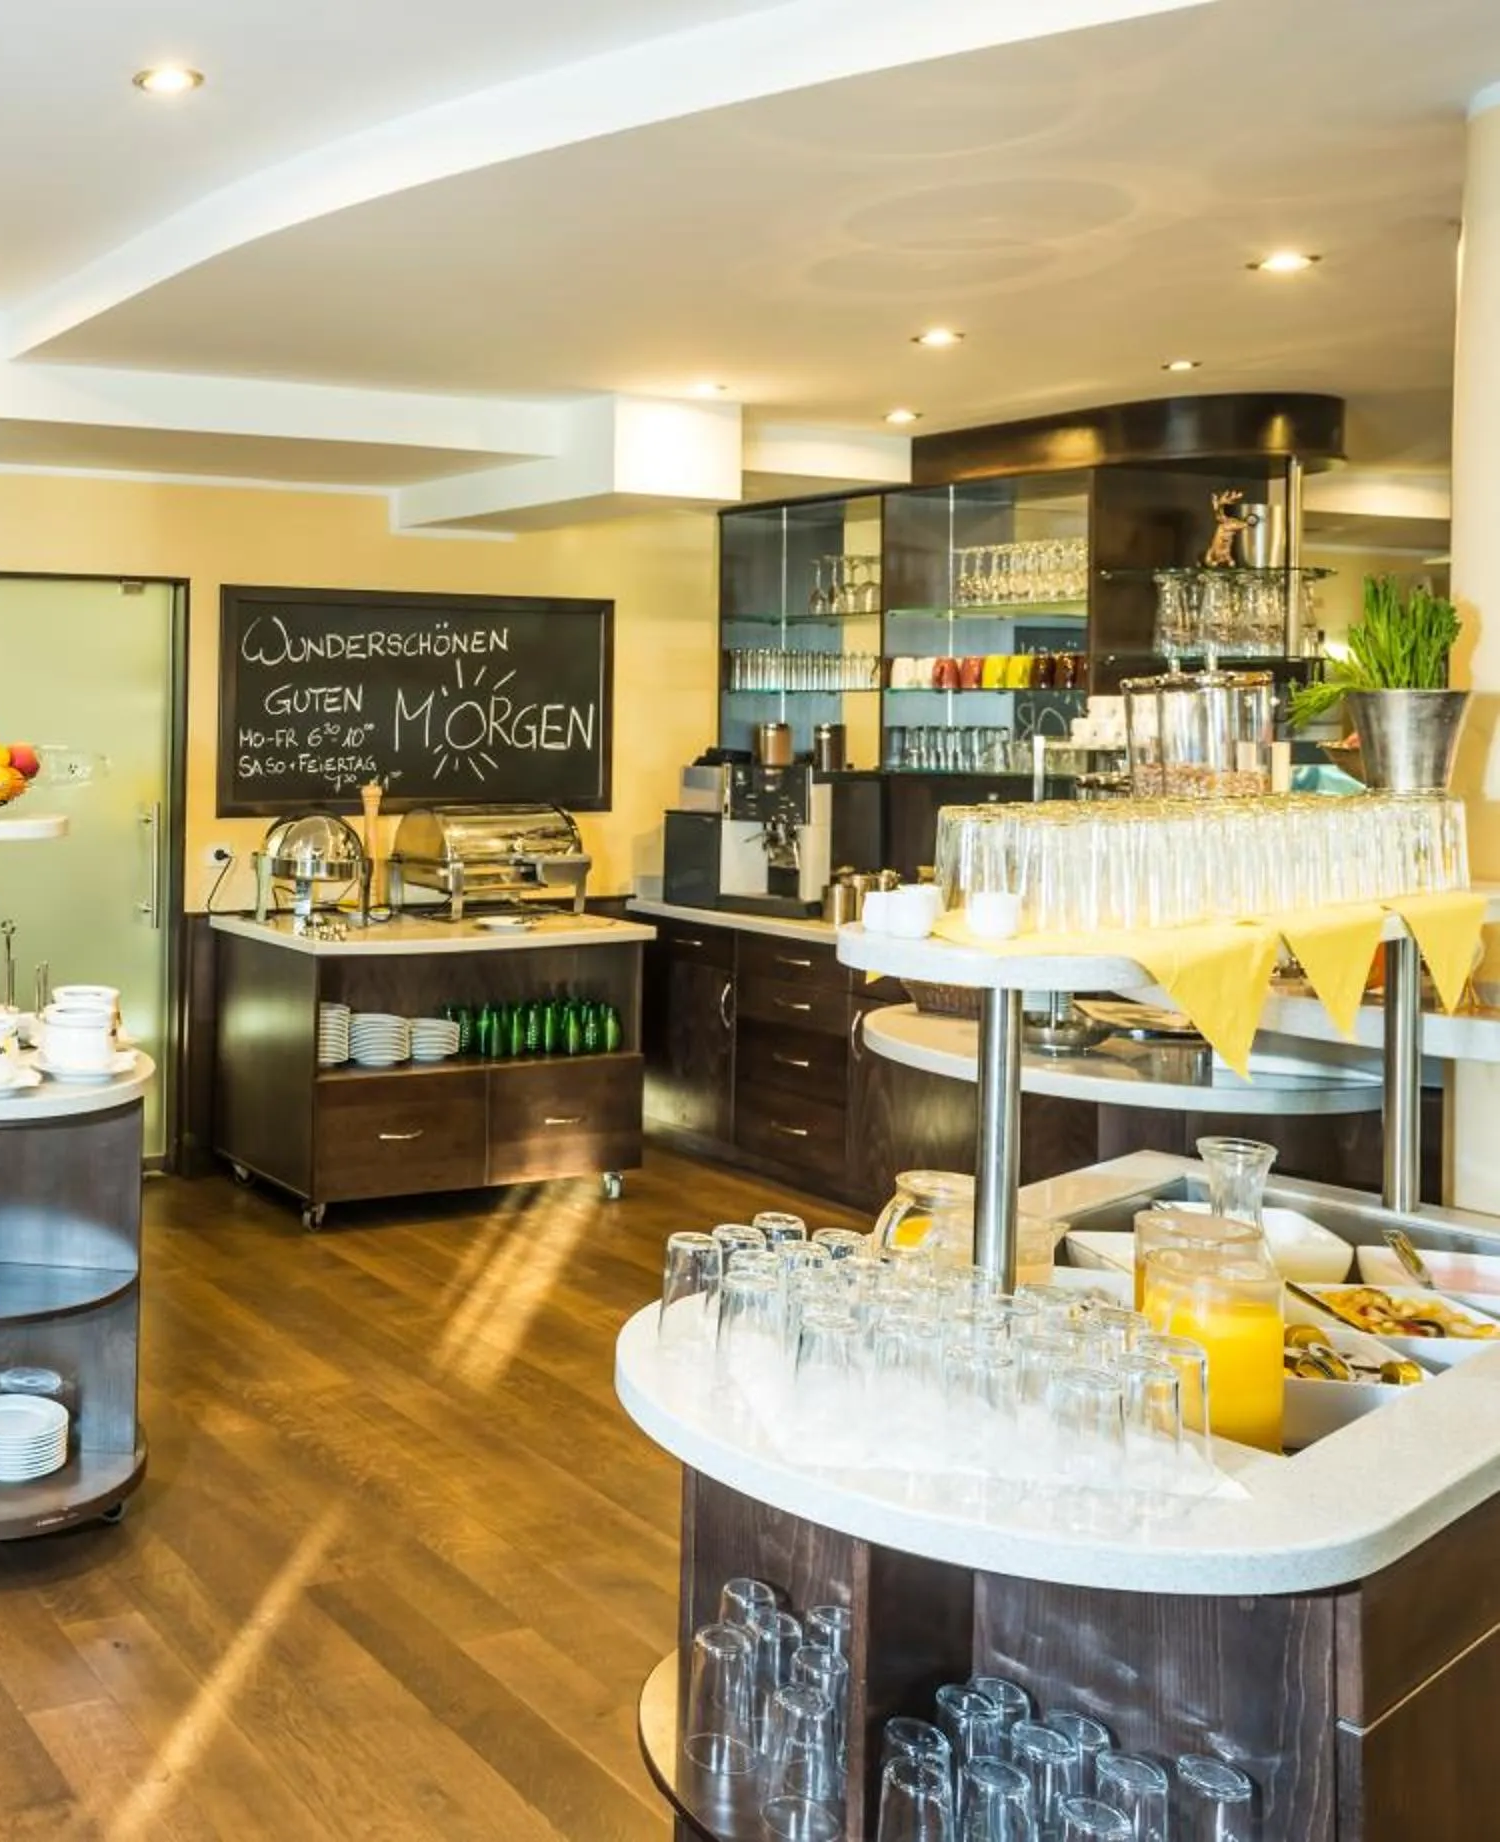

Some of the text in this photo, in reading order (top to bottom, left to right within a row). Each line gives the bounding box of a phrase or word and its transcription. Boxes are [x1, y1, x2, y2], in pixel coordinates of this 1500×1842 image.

[241, 616, 509, 666] WUNDERSCHÖNEN
[238, 726, 300, 749] MO-FR
[265, 684, 595, 752] GUTEN MORGEN
